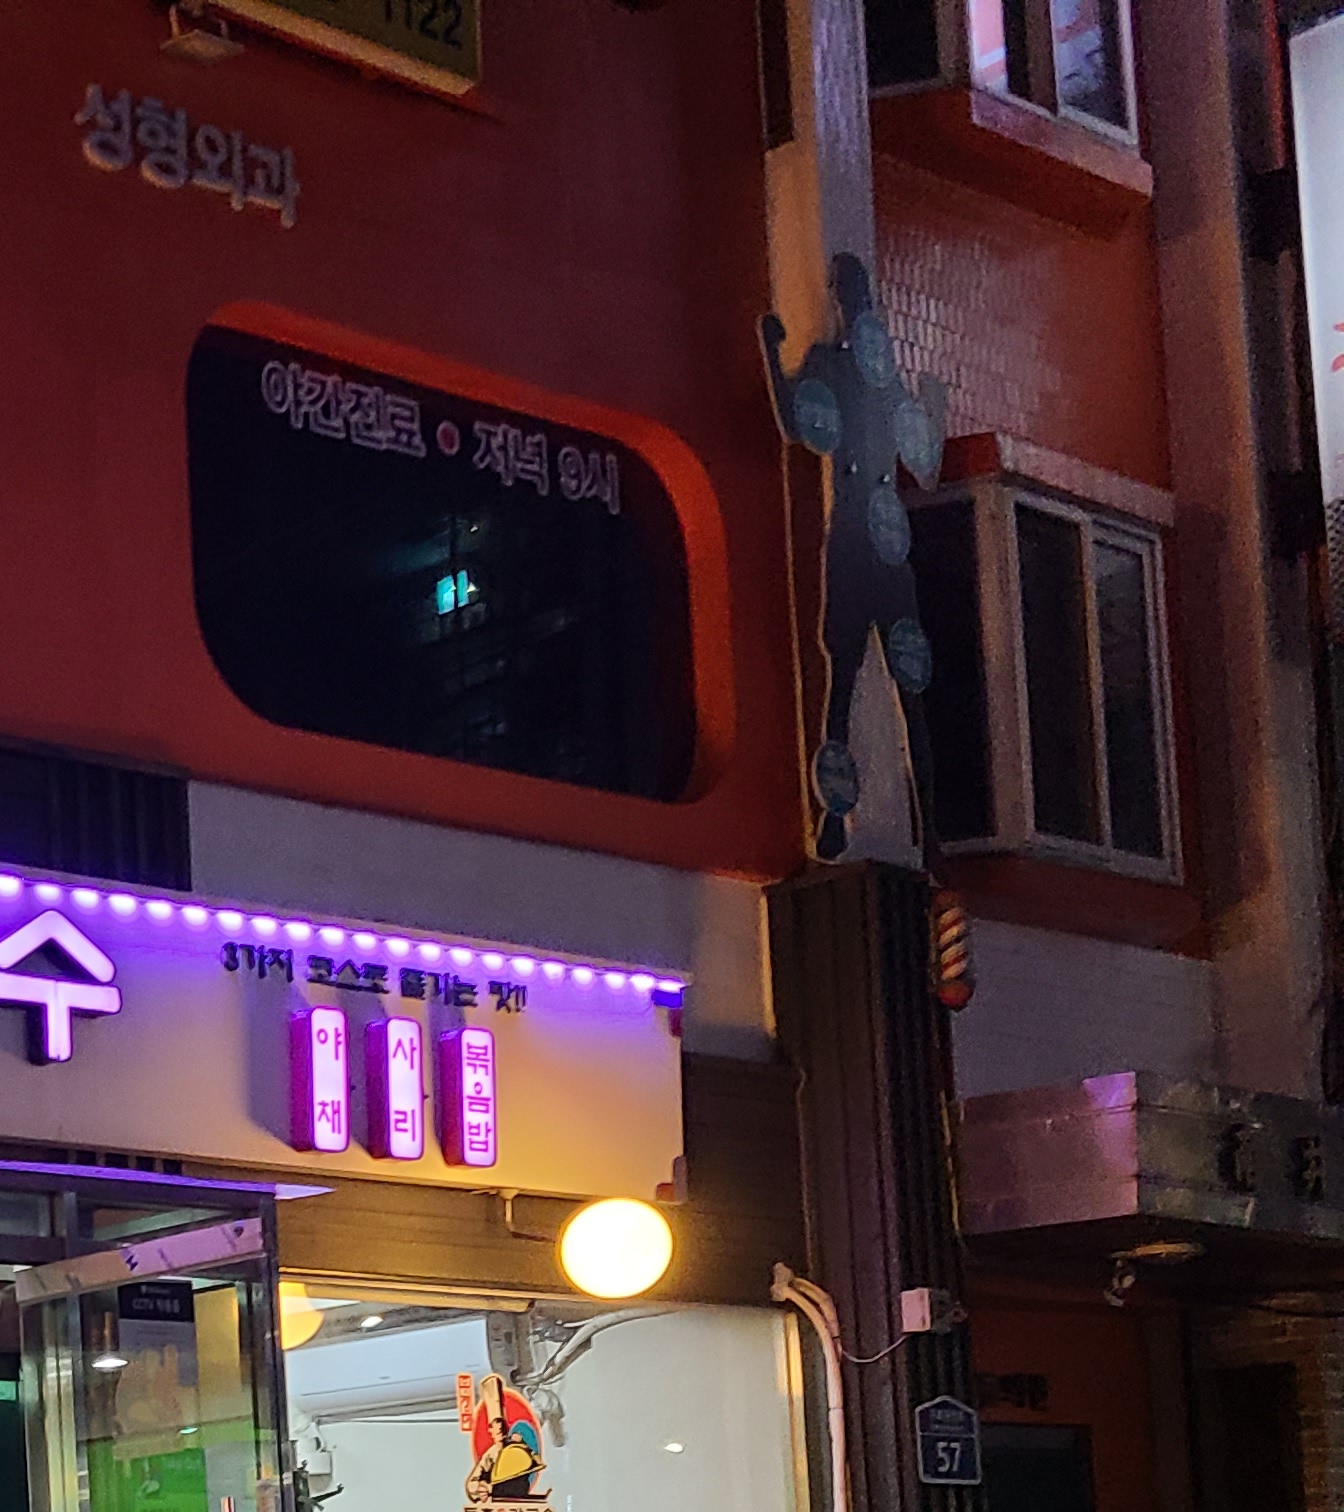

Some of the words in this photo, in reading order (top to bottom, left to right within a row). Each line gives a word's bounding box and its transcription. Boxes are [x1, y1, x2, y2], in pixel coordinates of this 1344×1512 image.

[74, 82, 301, 229] 성형외과
[261, 360, 428, 459] 야간진료
[472, 419, 551, 497] 저녁
[558, 447, 622, 515] 9시
[315, 1026, 343, 1135] 야채
[391, 1037, 418, 1143] 사리
[465, 1041, 493, 1153] 볶음밥
[936, 1441, 961, 1473] 57
